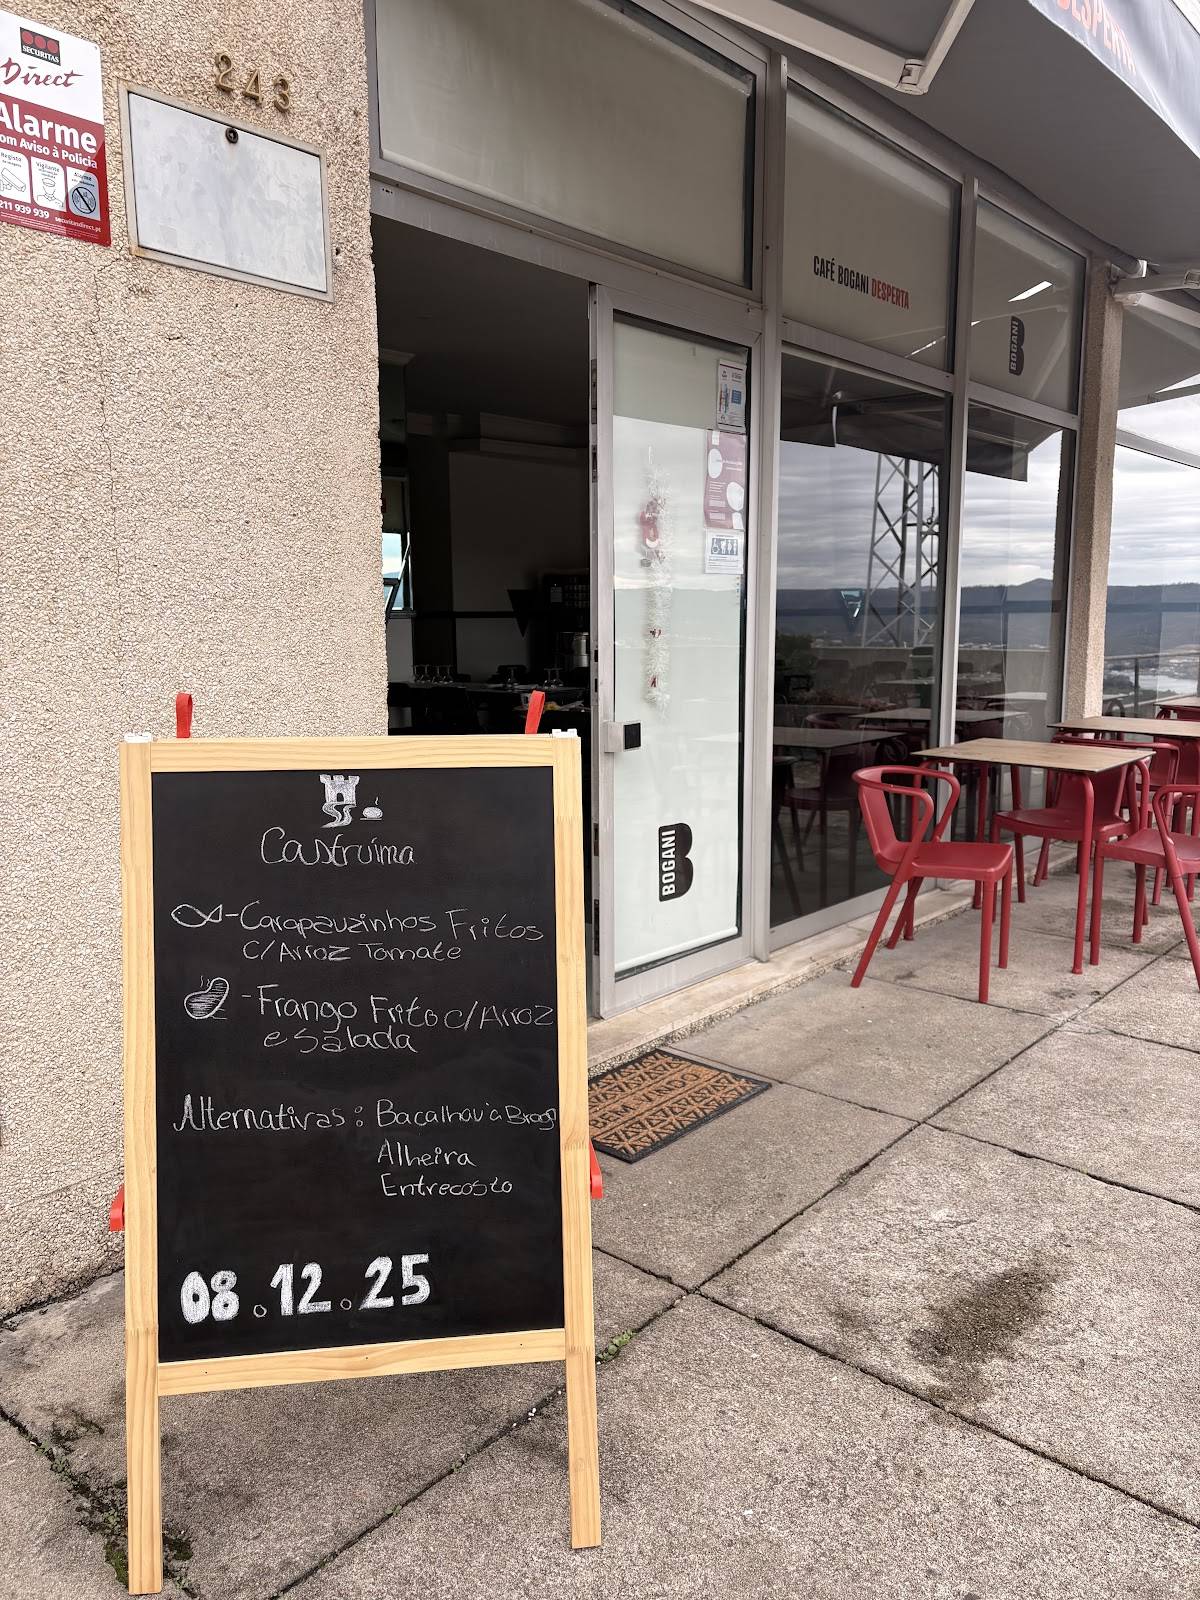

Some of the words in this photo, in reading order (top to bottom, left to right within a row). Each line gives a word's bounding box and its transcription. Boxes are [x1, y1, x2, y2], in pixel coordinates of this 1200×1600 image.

[22, 45, 60, 63] SECURITAS
[0, 57, 85, 88] Direct
[215, 54, 291, 113] 243
[0, 101, 97, 154] Alarme
[0, 133, 18, 147] om
[20, 138, 51, 156] Aviso
[52, 145, 60, 159] à
[14, 203, 32, 215] 939
[32, 207, 50, 219] 939
[813, 255, 836, 282] CAFÉ
[837, 264, 869, 295] BOGANI
[871, 278, 910, 310] DESPERTA
[1010, 320, 1019, 371] BOGANI
[661, 829, 676, 897] BOGANI
[444, 908, 544, 942] Fritos
[357, 941, 462, 962] Tomate
[370, 994, 440, 1029] Frito
[263, 1031, 289, 1048] e
[376, 1138, 477, 1168] Alheira
[380, 1172, 513, 1198] Entrecosto
